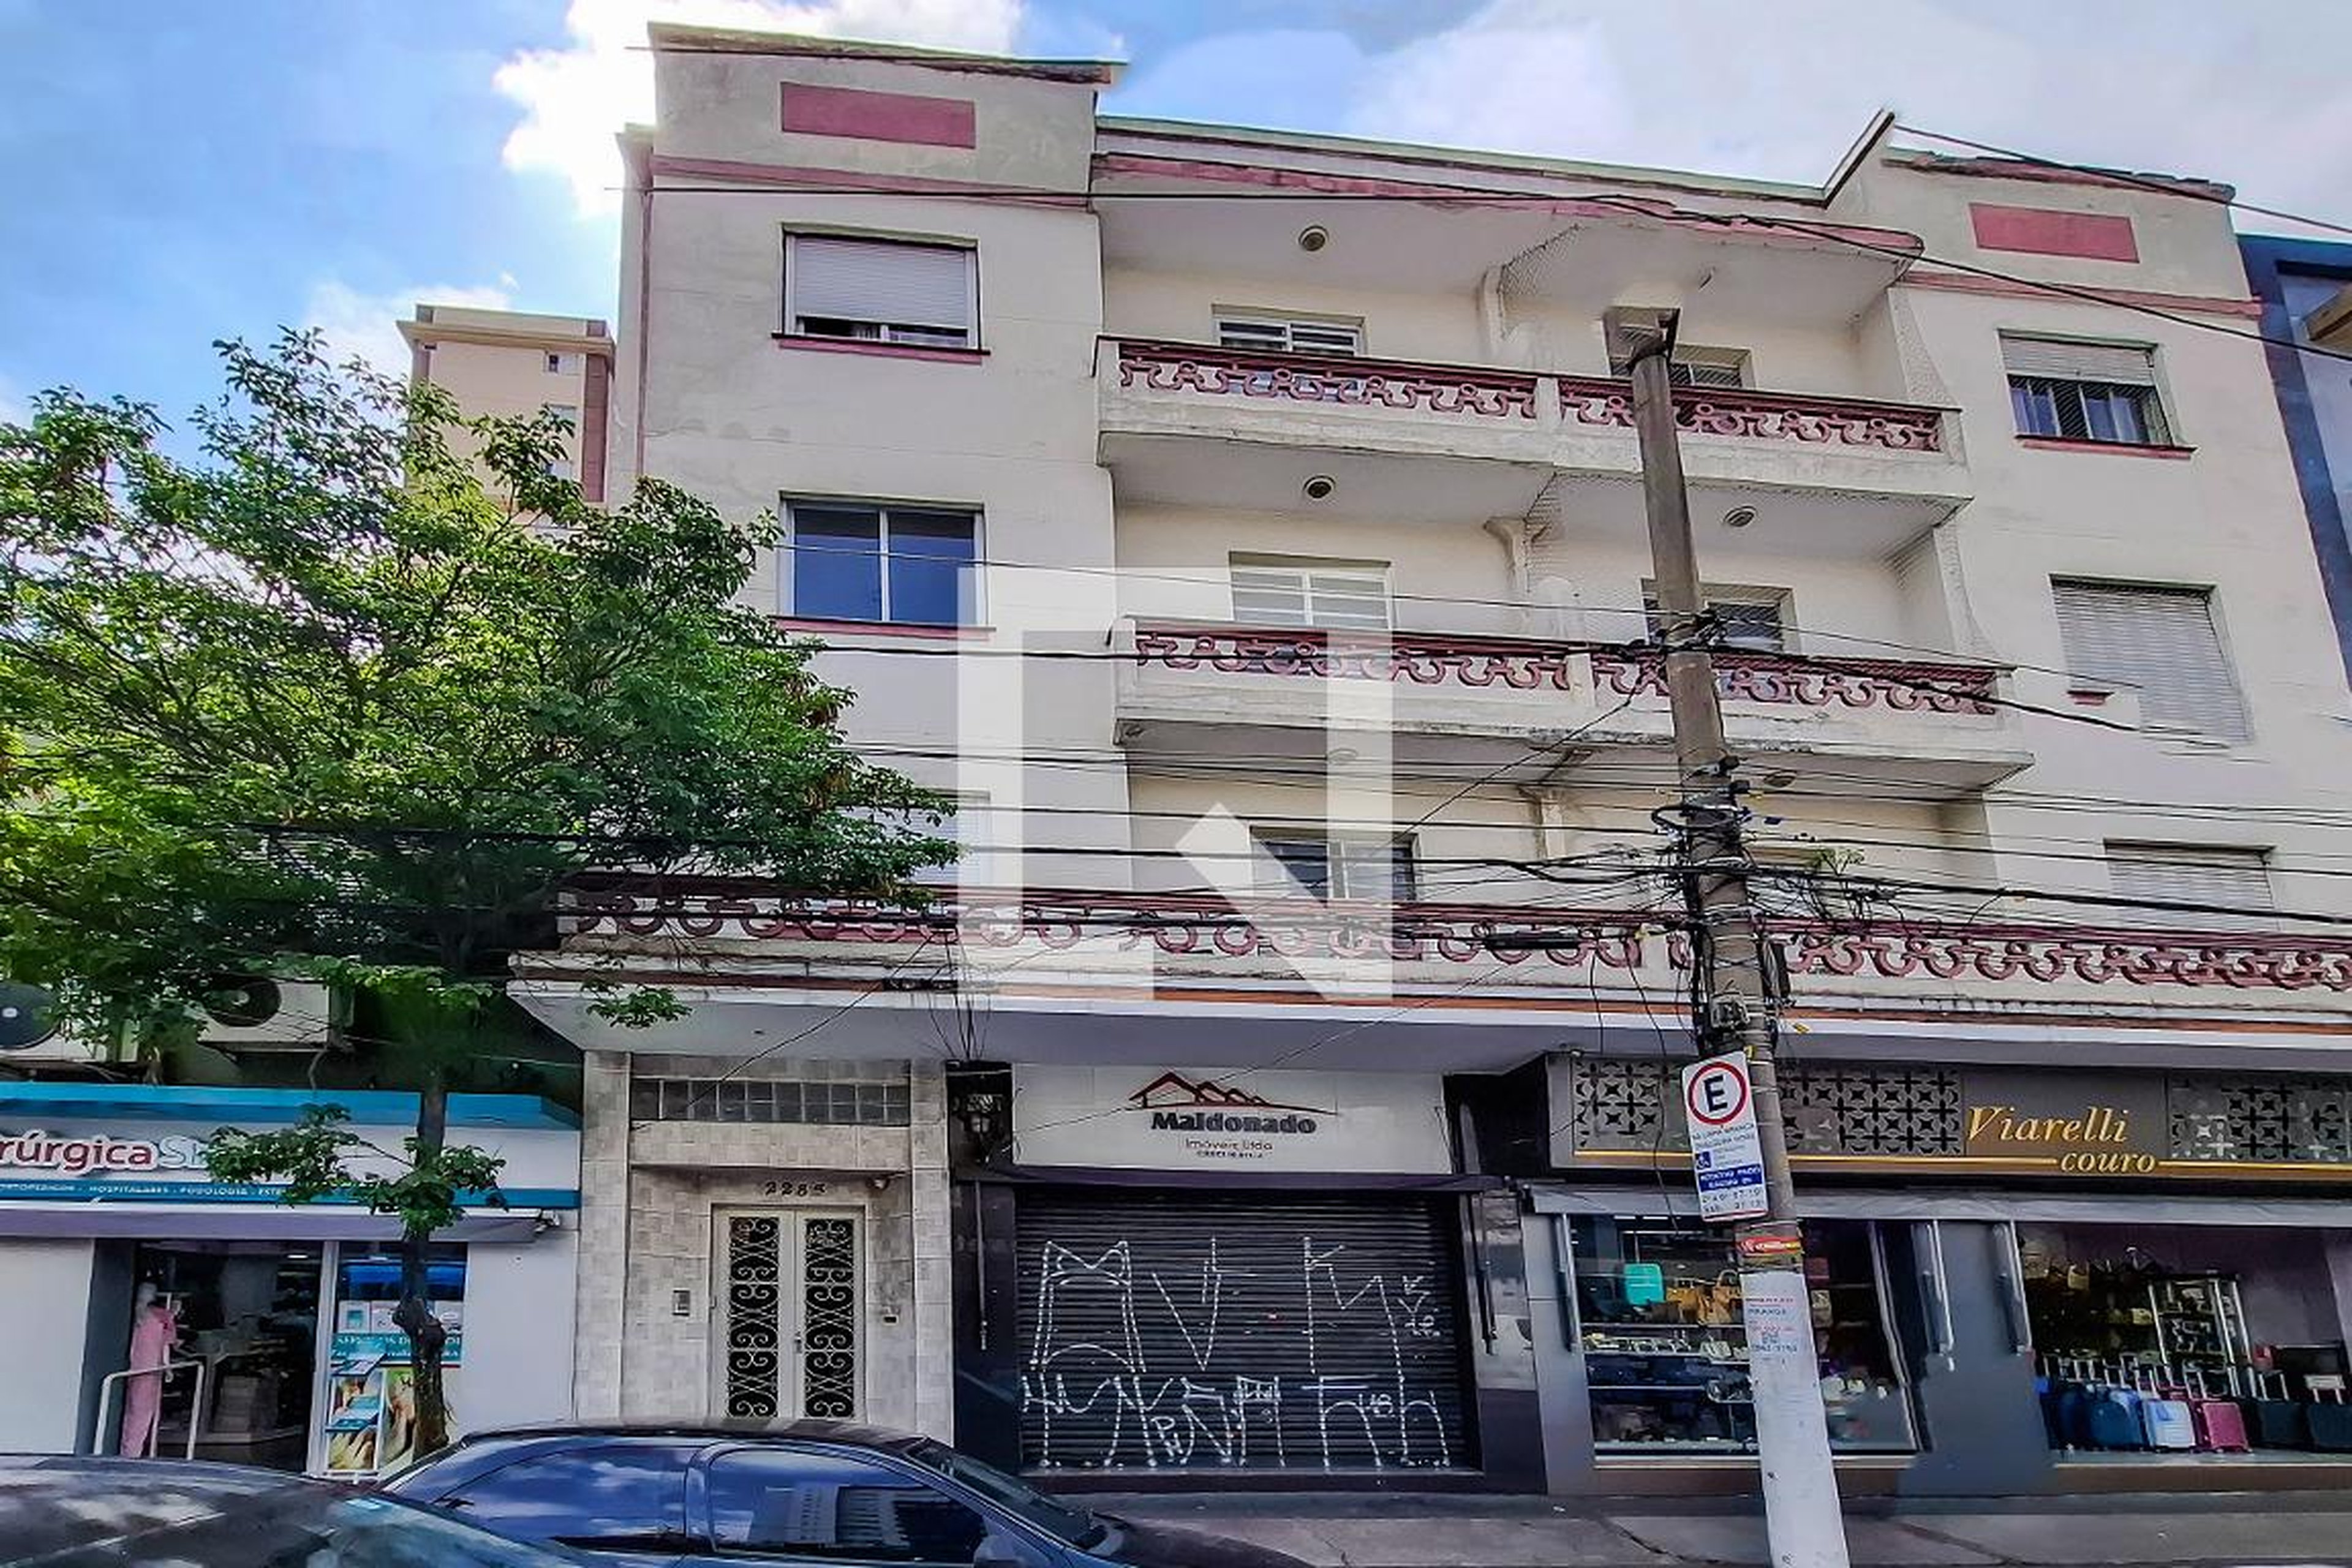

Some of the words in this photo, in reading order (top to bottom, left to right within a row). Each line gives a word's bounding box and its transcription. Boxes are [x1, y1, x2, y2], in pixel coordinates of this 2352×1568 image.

[1703, 1075, 1728, 1112] E
[1151, 1112, 1316, 1133] Maldonado
[1968, 1106, 2128, 1142] Viarelli
[2060, 1152, 2155, 1173] couro
